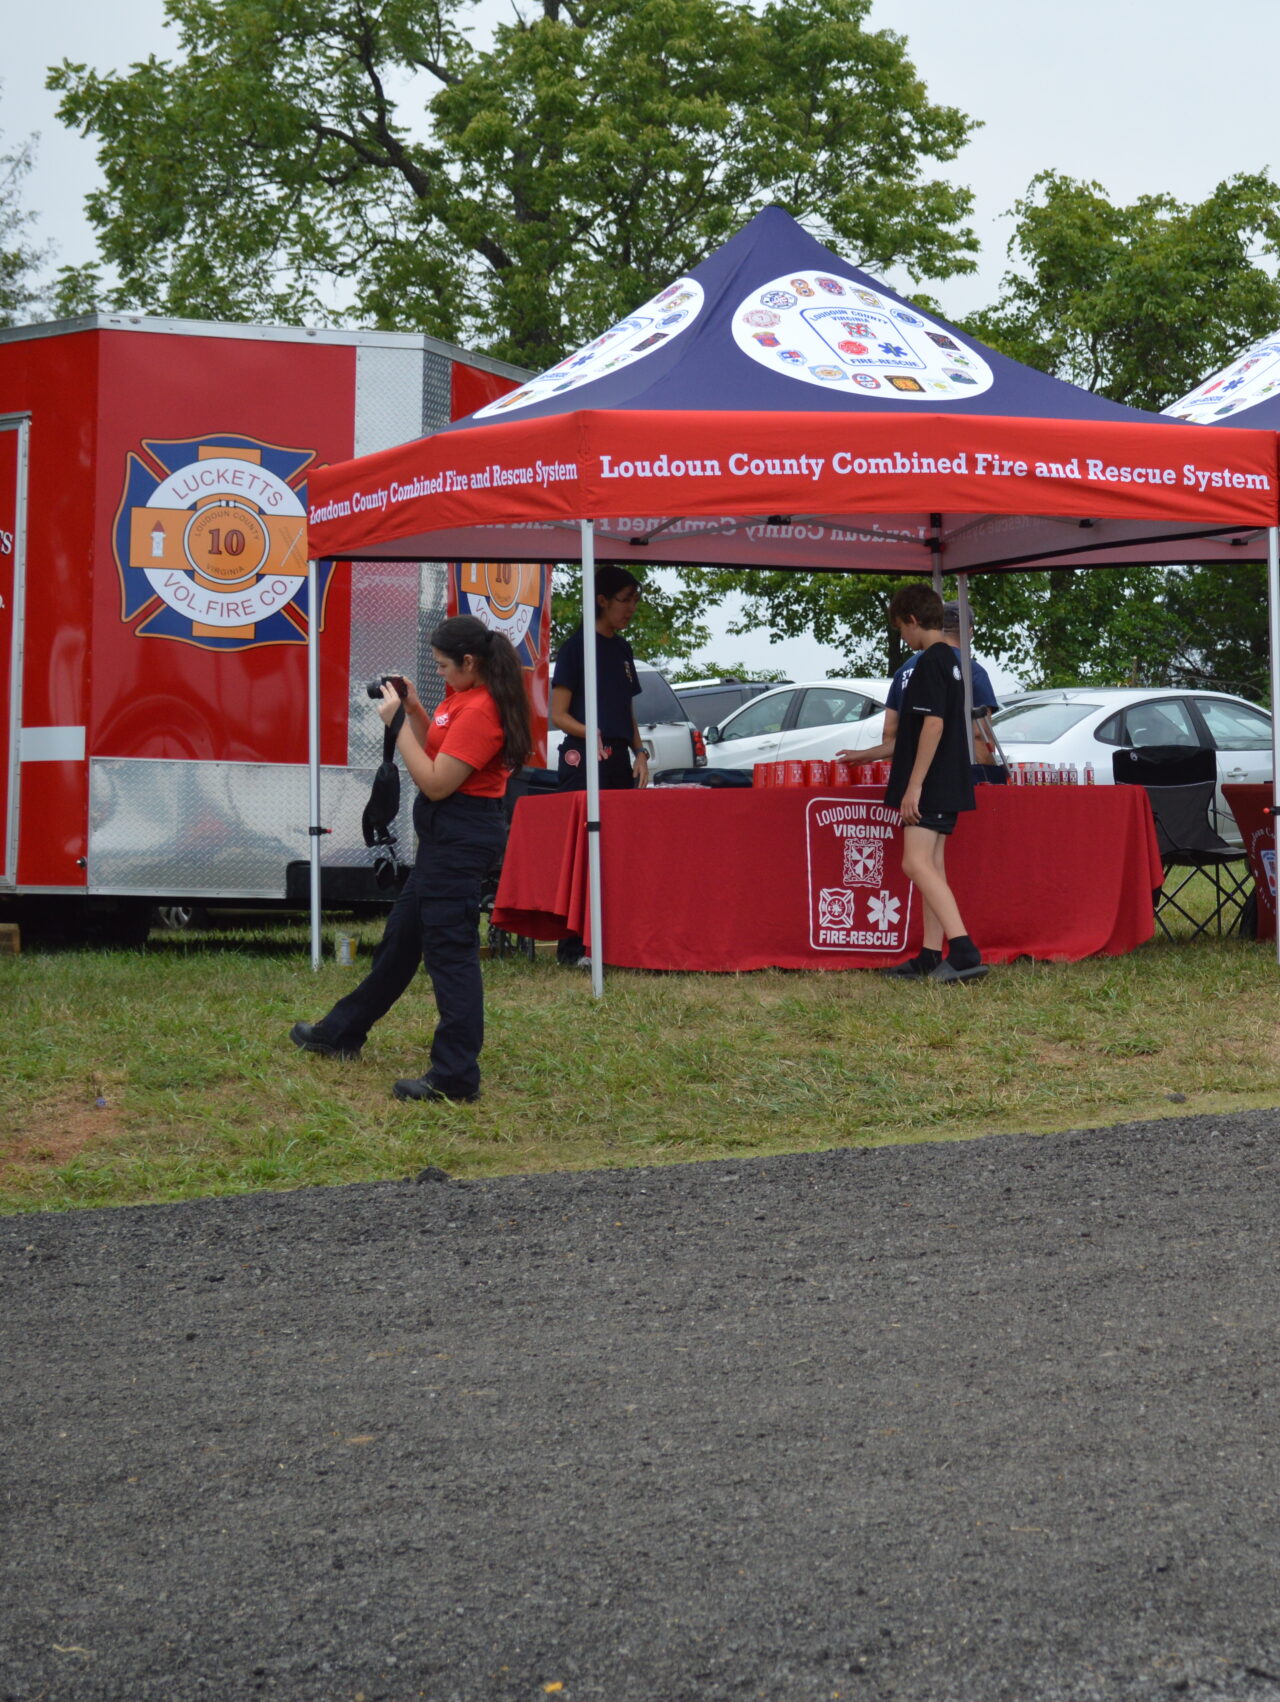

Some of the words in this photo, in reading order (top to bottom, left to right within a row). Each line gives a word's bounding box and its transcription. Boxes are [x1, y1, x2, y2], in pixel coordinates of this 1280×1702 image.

[809, 310, 848, 322] LOUDOUN
[850, 310, 888, 324] COUNTY
[849, 358, 920, 367] FIRE-RESCUE
[600, 454, 721, 478] Loudoun
[728, 452, 825, 481] County
[832, 451, 967, 475] Combined
[974, 453, 1028, 477] Fire
[1035, 458, 1082, 480] and
[1086, 458, 1177, 485] Rescue
[1183, 464, 1270, 492] System
[172, 468, 283, 507] LUCKETTS
[309, 500, 351, 525] Loudoun
[352, 487, 388, 511] County
[390, 472, 443, 503] Combined
[444, 470, 468, 493] Fire
[470, 466, 491, 489] and
[493, 464, 534, 487] Rescue
[535, 460, 578, 488] System
[195, 510, 231, 537] LOUDOUN
[233, 512, 260, 541] COUNTY
[208, 528, 245, 556] 10
[206, 564, 245, 576] VIRGINIA
[163, 573, 203, 613] VOL.
[205, 600, 256, 618] FIRE
[259, 579, 294, 606] CO.
[816, 805, 867, 827] LOUDOUN
[870, 806, 902, 827] COUN
[833, 824, 894, 839] VIRGINIA
[818, 930, 899, 946] FIRE-RESCUE
